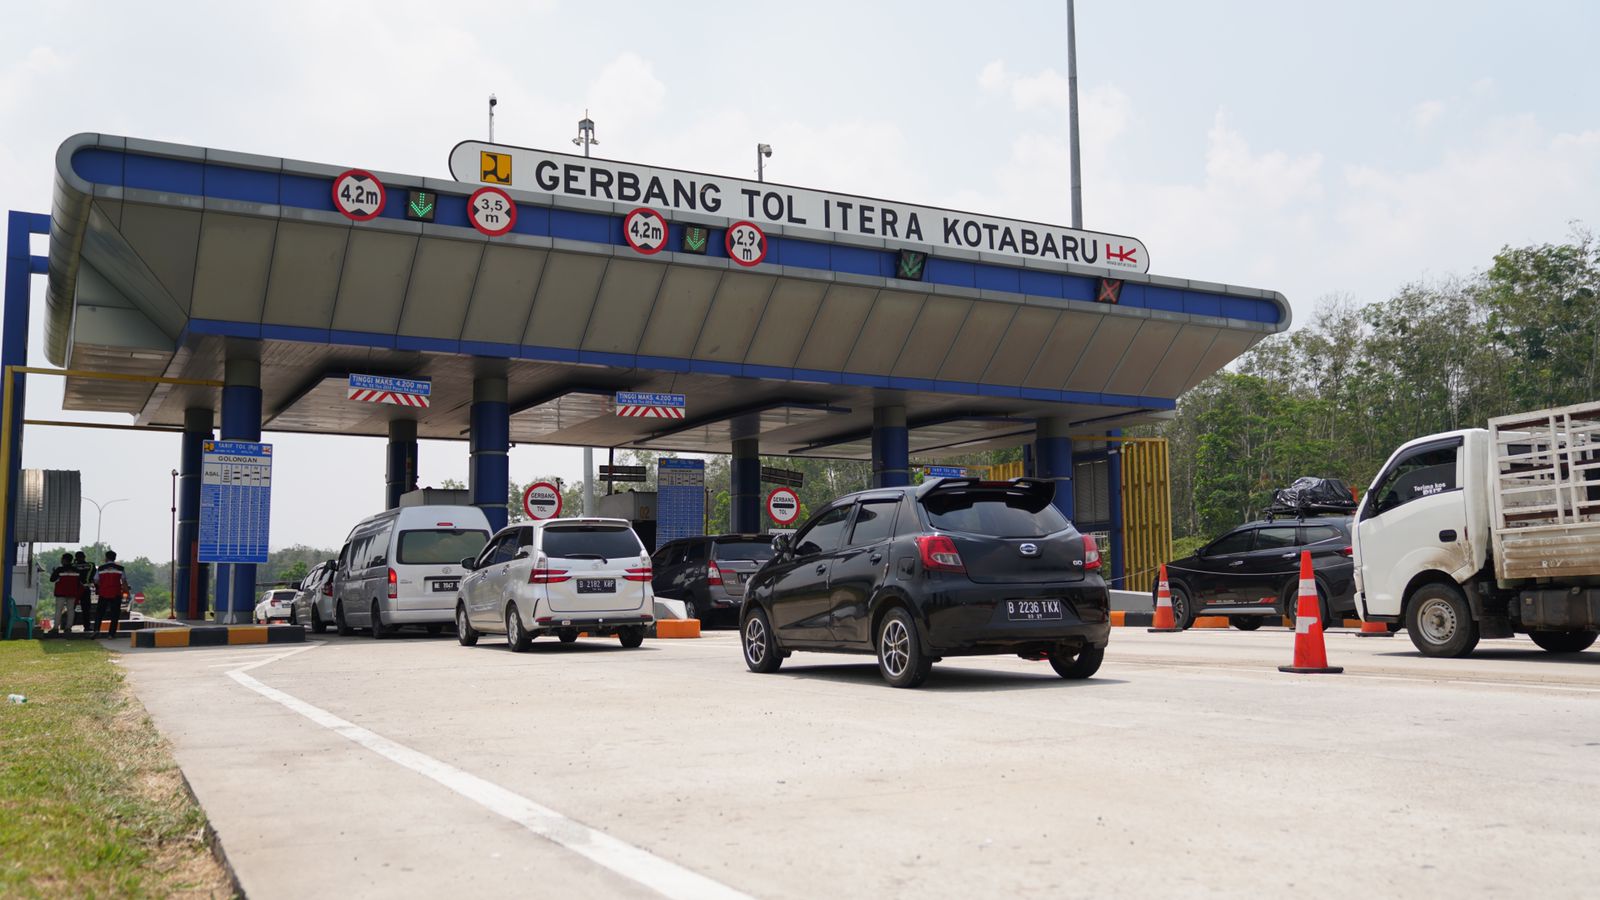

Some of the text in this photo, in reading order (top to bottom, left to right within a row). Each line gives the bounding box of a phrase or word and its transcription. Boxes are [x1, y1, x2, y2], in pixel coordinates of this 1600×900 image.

[341, 184, 378, 205] 4,2m
[481, 198, 503, 212] 3,5
[535, 160, 1098, 264] GERBANG TOL ITERA KOTABARU
[485, 214, 499, 223] m
[631, 220, 661, 240] 4,2m
[737, 229, 755, 247] 2,9
[743, 248, 752, 260] m
[1106, 243, 1137, 263] HK
[352, 375, 373, 383] TINGGI
[218, 455, 258, 463] GOLONGAN
[1008, 601, 1059, 614] B 2236 TKX
